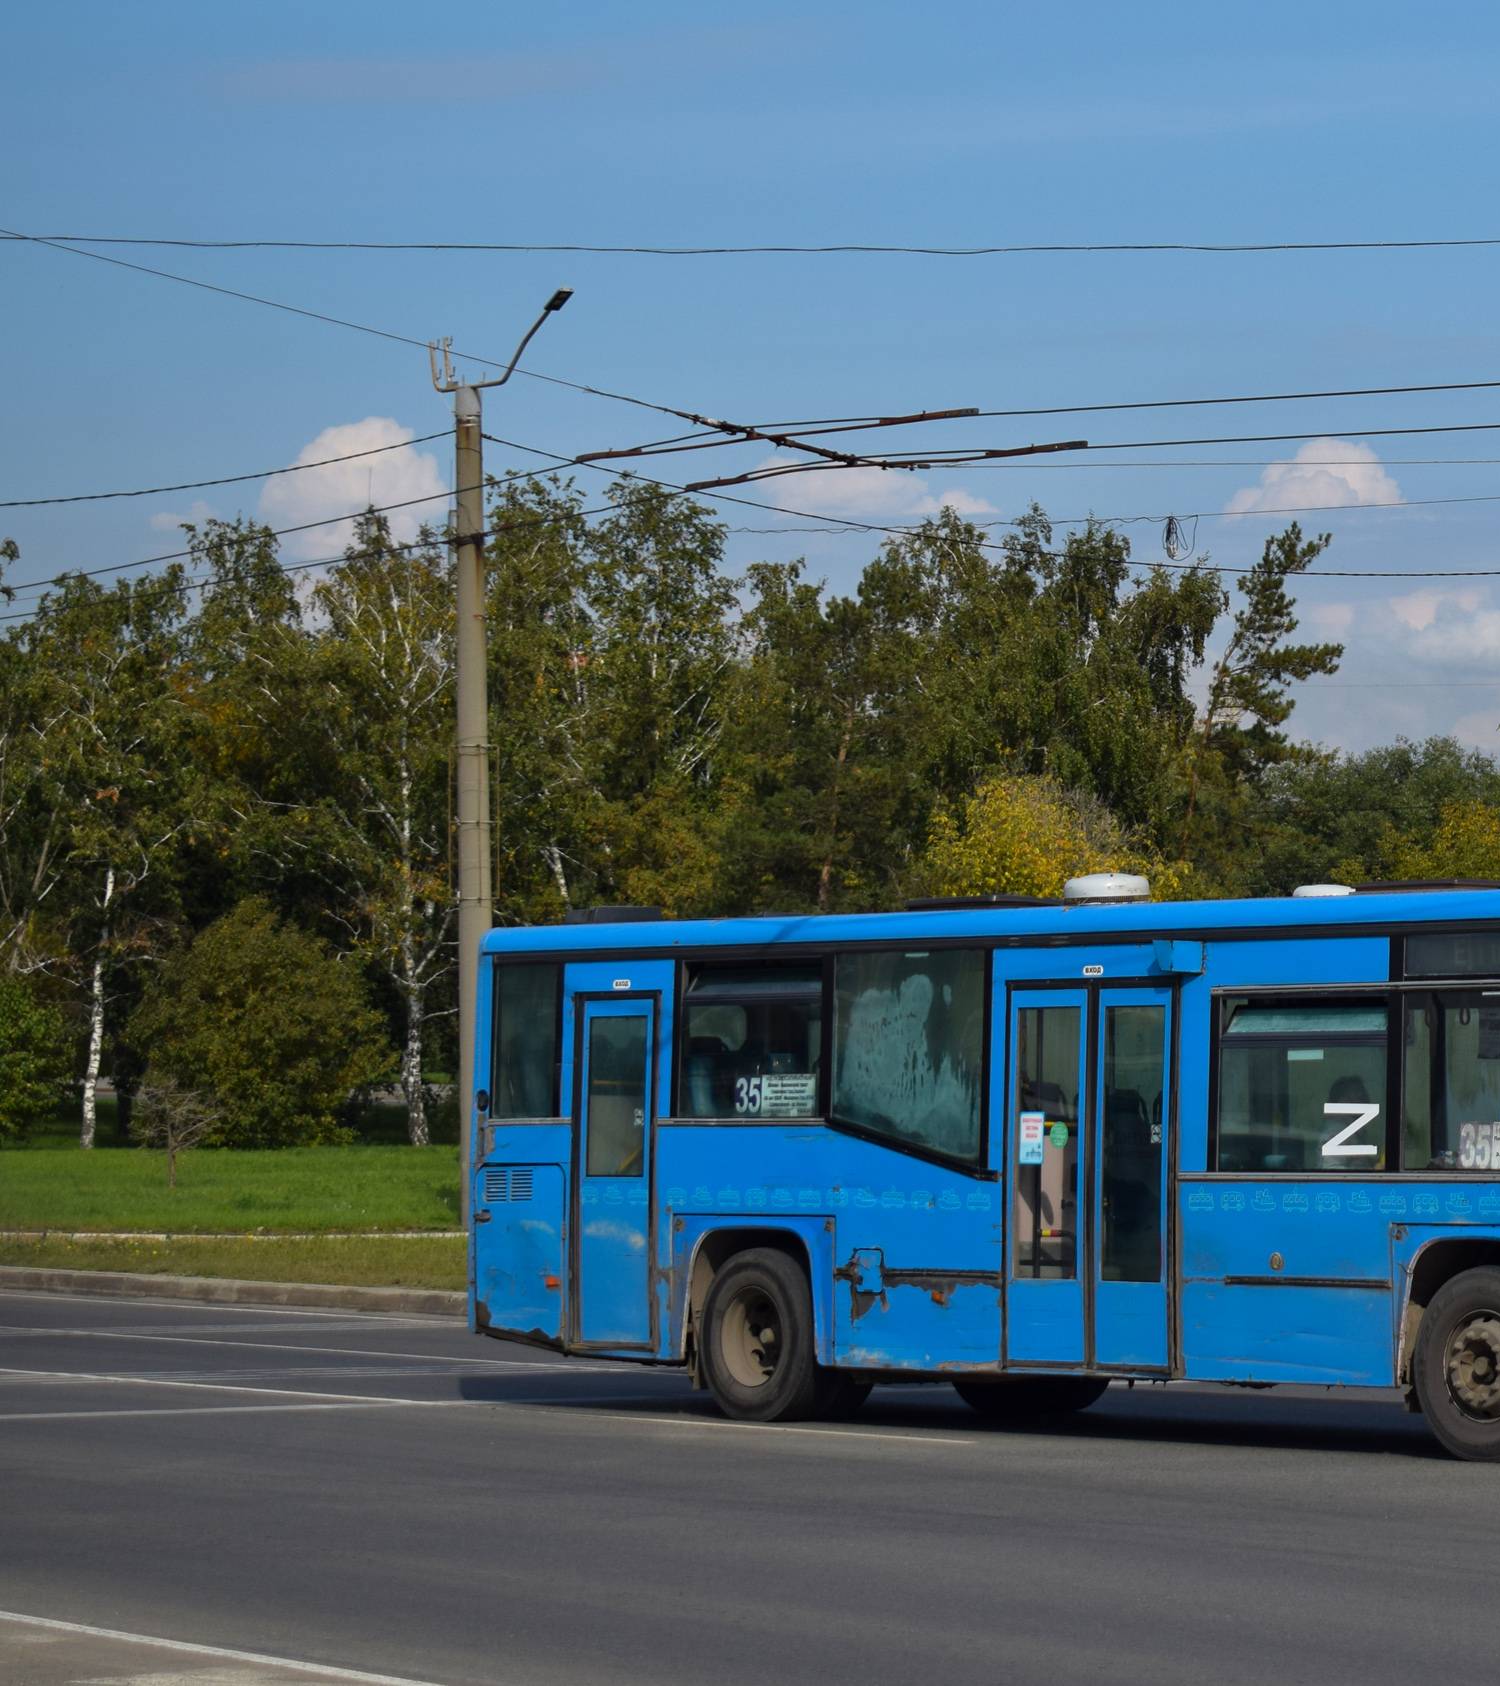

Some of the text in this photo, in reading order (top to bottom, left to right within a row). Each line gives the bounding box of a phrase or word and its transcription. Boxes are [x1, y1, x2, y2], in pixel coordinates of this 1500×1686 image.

[736, 1077, 761, 1113] 35
[1321, 1102, 1380, 1156] Z
[1460, 1123, 1491, 1168] 35
